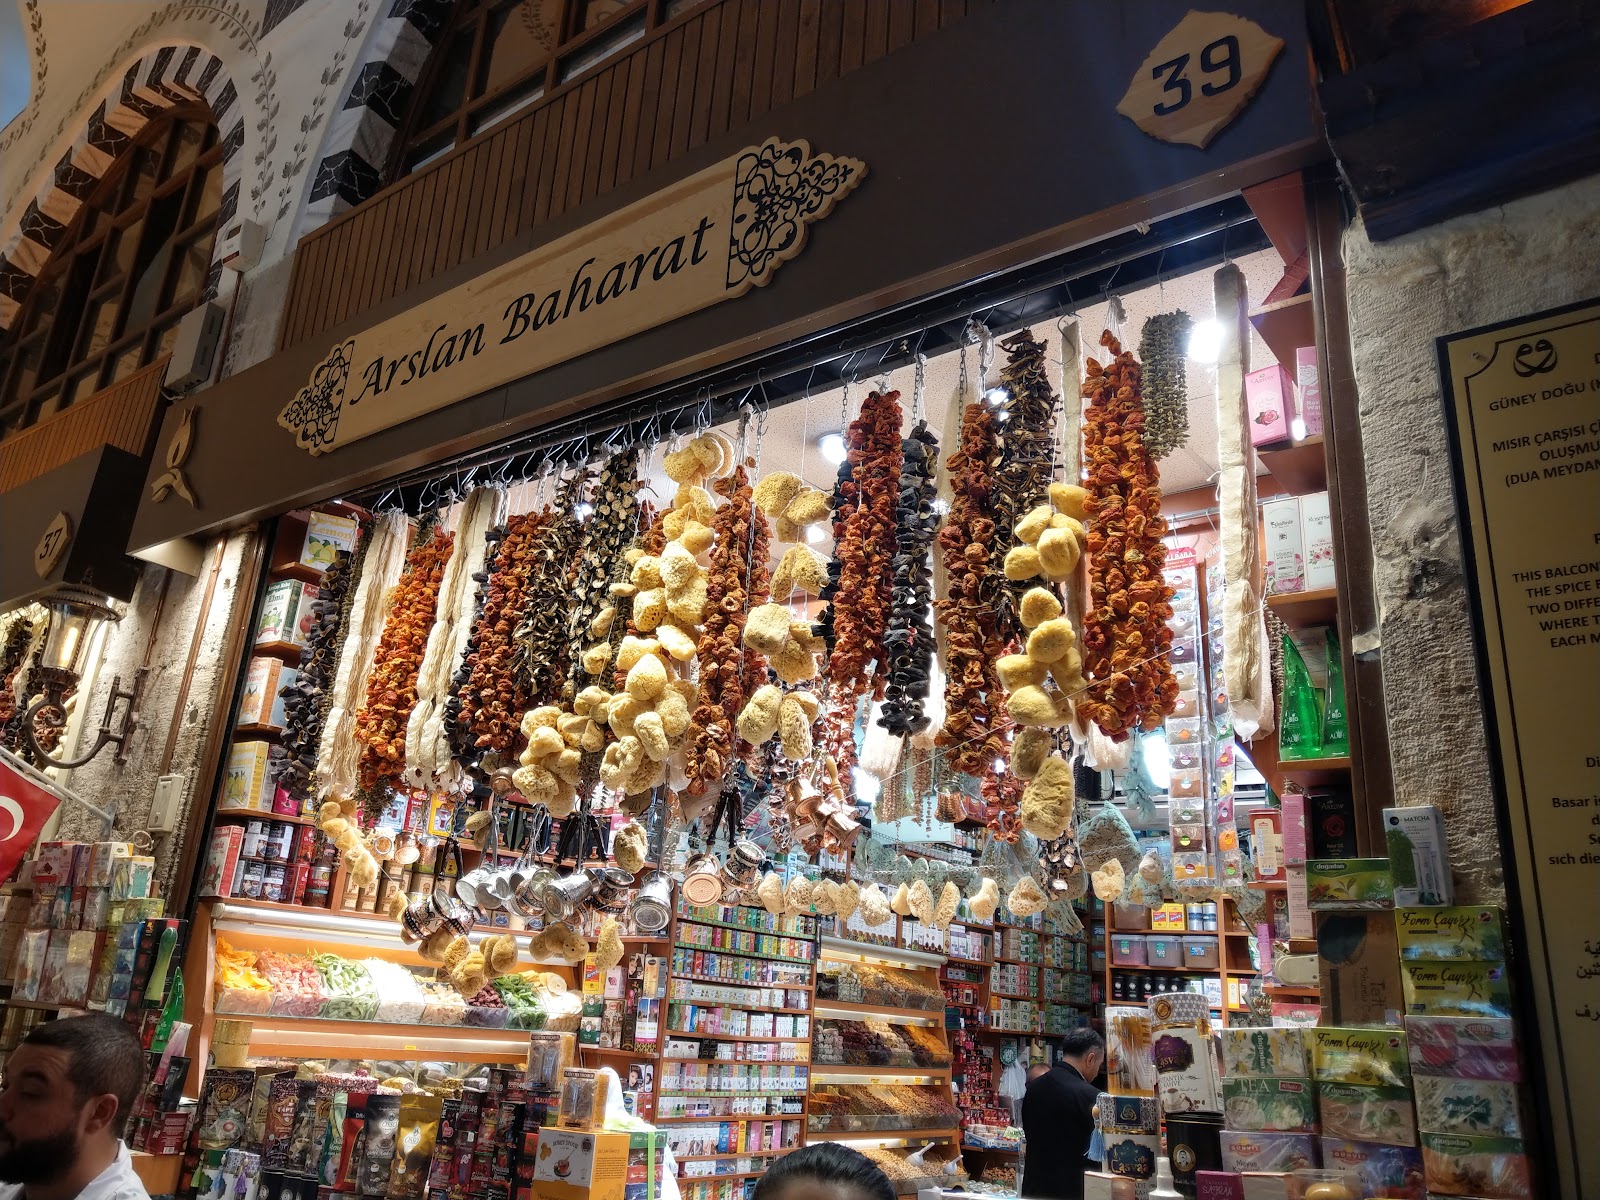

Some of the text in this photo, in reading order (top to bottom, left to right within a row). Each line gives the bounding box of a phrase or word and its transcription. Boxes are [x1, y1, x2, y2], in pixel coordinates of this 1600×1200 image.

[1152, 35, 1242, 116] 39
[348, 216, 716, 406] Arslan Baharat
[1489, 392, 1537, 411] GÜNEY
[1541, 382, 1585, 400] DOĞU
[1492, 436, 1530, 453] MISIR
[1534, 424, 1585, 446] ÇARŞISI
[1505, 470, 1540, 488] (DUA
[39, 527, 63, 560] 37
[1512, 562, 1600, 583] THIS BALCON
[1525, 586, 1551, 598] THE
[1555, 580, 1591, 595] SPICE
[1527, 602, 1560, 615] TWO
[1539, 616, 1590, 631] WHERE
[1550, 634, 1586, 648] EACH
[1552, 797, 1590, 808] Basar
[1401, 912, 1431, 926] Form
[1409, 967, 1438, 982] Form
[1317, 1033, 1345, 1048] Form
[1237, 1079, 1271, 1092] TEA
[1236, 1159, 1258, 1167] Meyve
